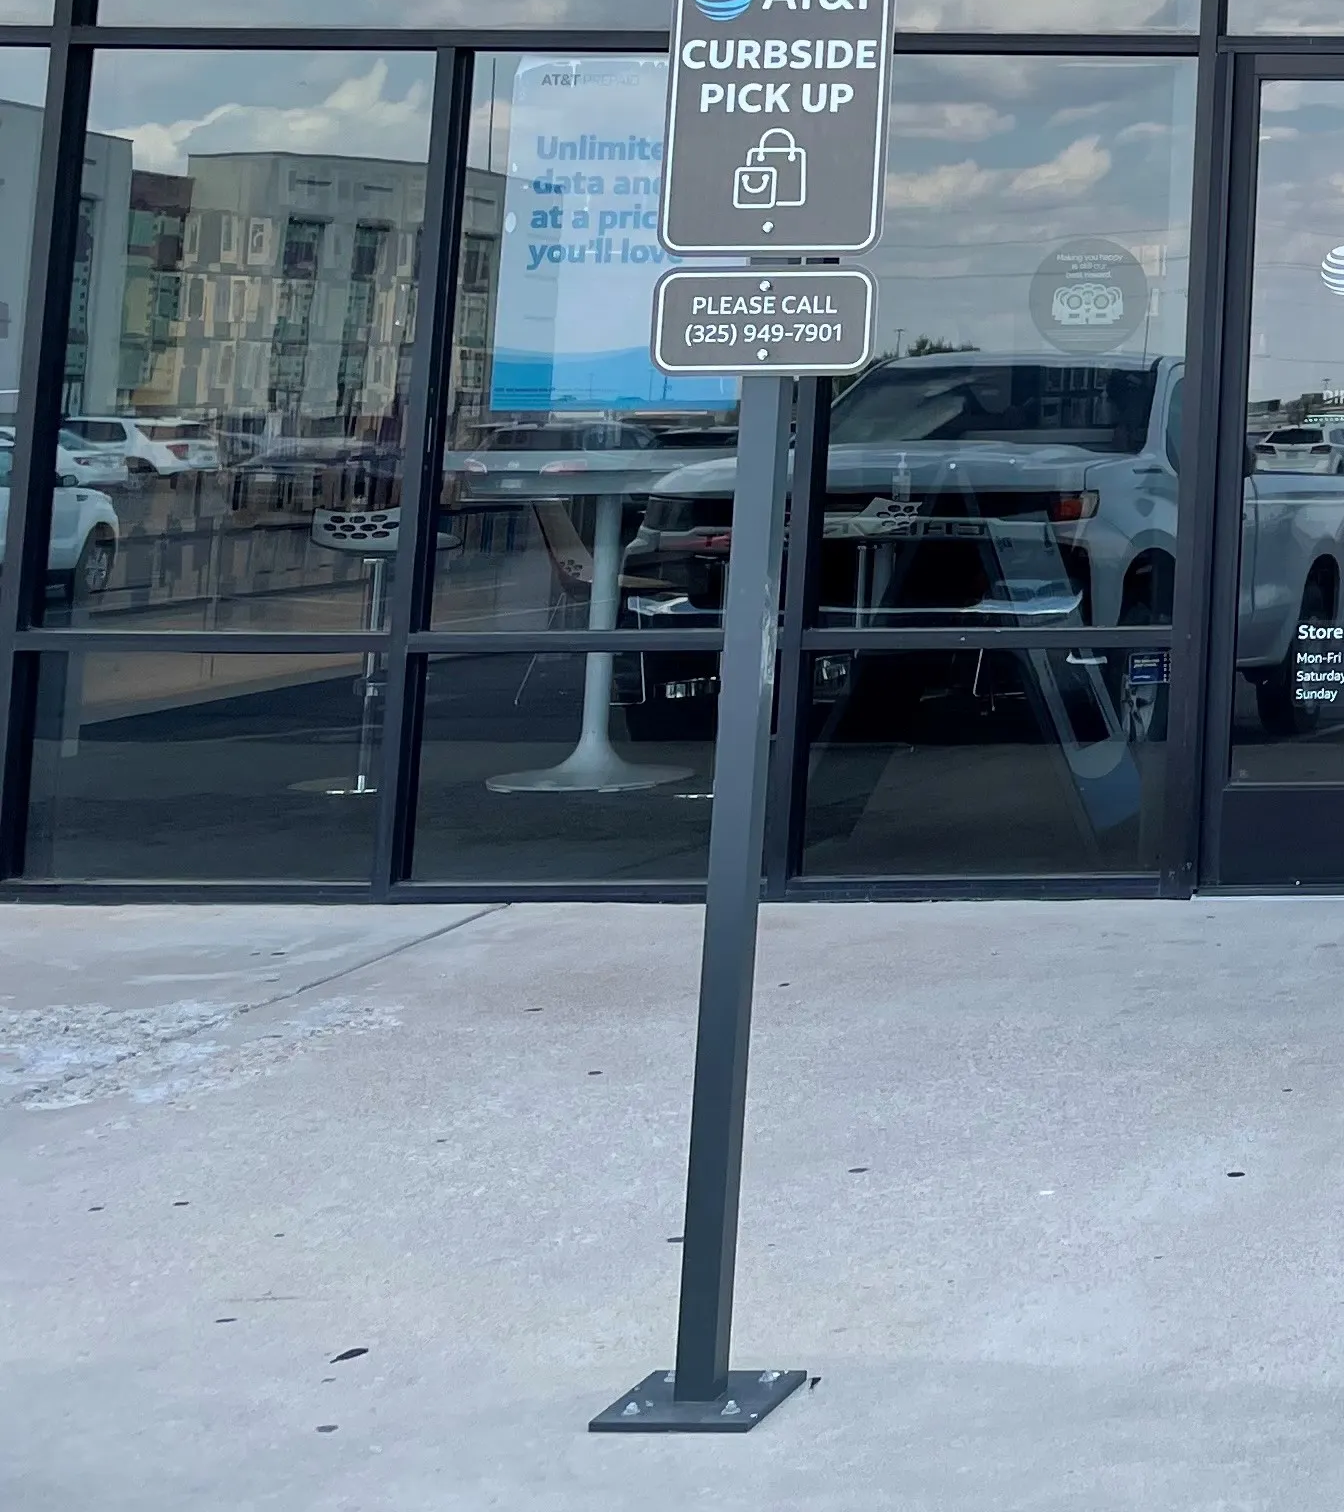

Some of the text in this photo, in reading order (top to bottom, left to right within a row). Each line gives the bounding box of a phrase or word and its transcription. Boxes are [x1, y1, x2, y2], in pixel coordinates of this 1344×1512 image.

[682, 39, 877, 71] CURBSIDE
[541, 74, 581, 86] AT&T
[699, 83, 854, 114] PICK UP
[536, 134, 664, 161] Unlimite
[532, 168, 605, 195] data
[530, 204, 657, 236] at a pric
[526, 238, 611, 271] you'll
[692, 296, 838, 315] PLEASE CALL
[684, 324, 843, 346] (325) 949-7901
[1298, 624, 1343, 640] Store
[1297, 652, 1342, 664] Mon-Fri
[1295, 688, 1337, 703] Sunday
